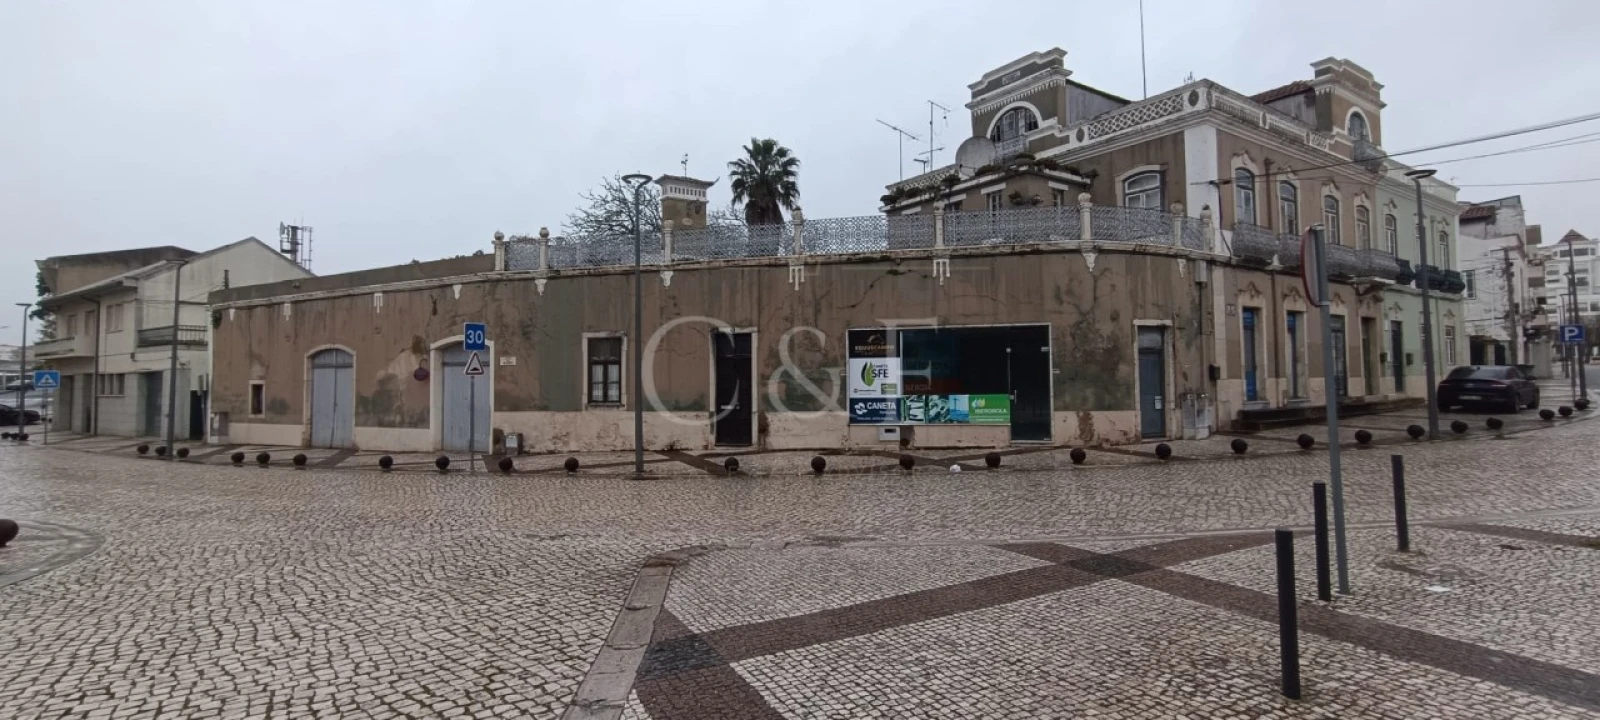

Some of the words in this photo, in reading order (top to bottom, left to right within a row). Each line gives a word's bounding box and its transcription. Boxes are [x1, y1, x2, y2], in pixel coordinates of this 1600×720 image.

[467, 330, 484, 344] 30
[1564, 326, 1579, 341] P
[871, 368, 890, 378] SFE
[866, 401, 897, 410] CANETA
